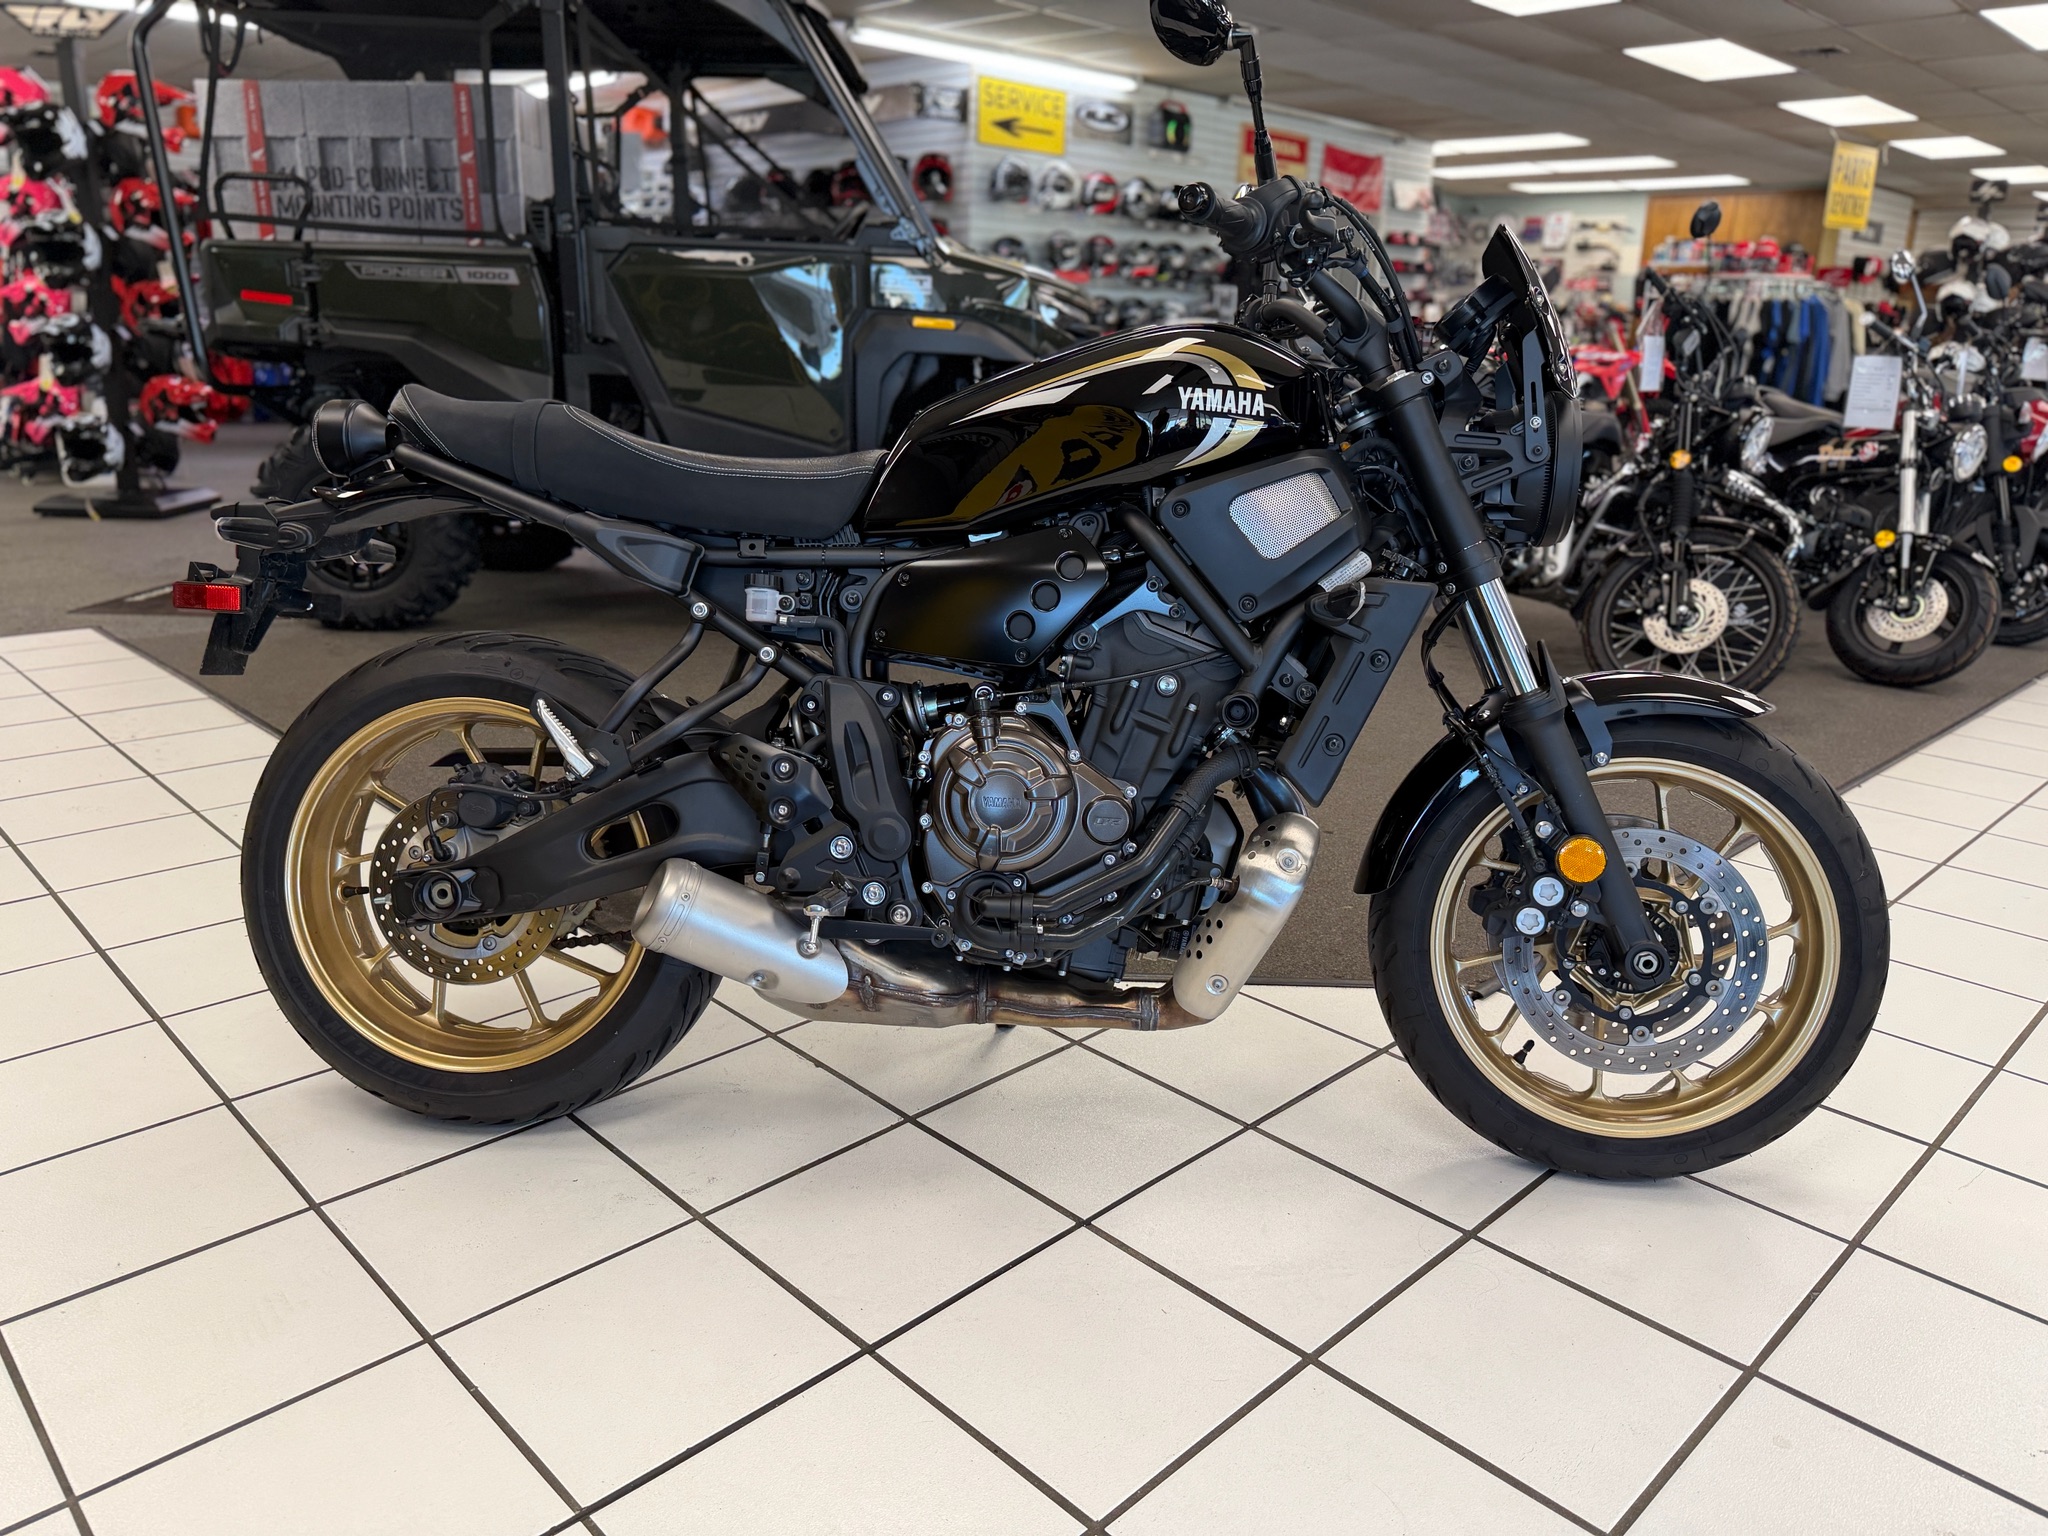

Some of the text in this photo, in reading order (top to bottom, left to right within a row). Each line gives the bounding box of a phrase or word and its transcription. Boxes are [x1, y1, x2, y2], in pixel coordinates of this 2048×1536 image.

[983, 82, 1062, 120] SERVICE
[276, 195, 382, 220] MUNTING
[388, 195, 465, 222] POINTS
[361, 265, 509, 281] PIONEER 1000
[1178, 386, 1265, 416] YAMAHA
[982, 795, 1021, 809] YAMAHA
